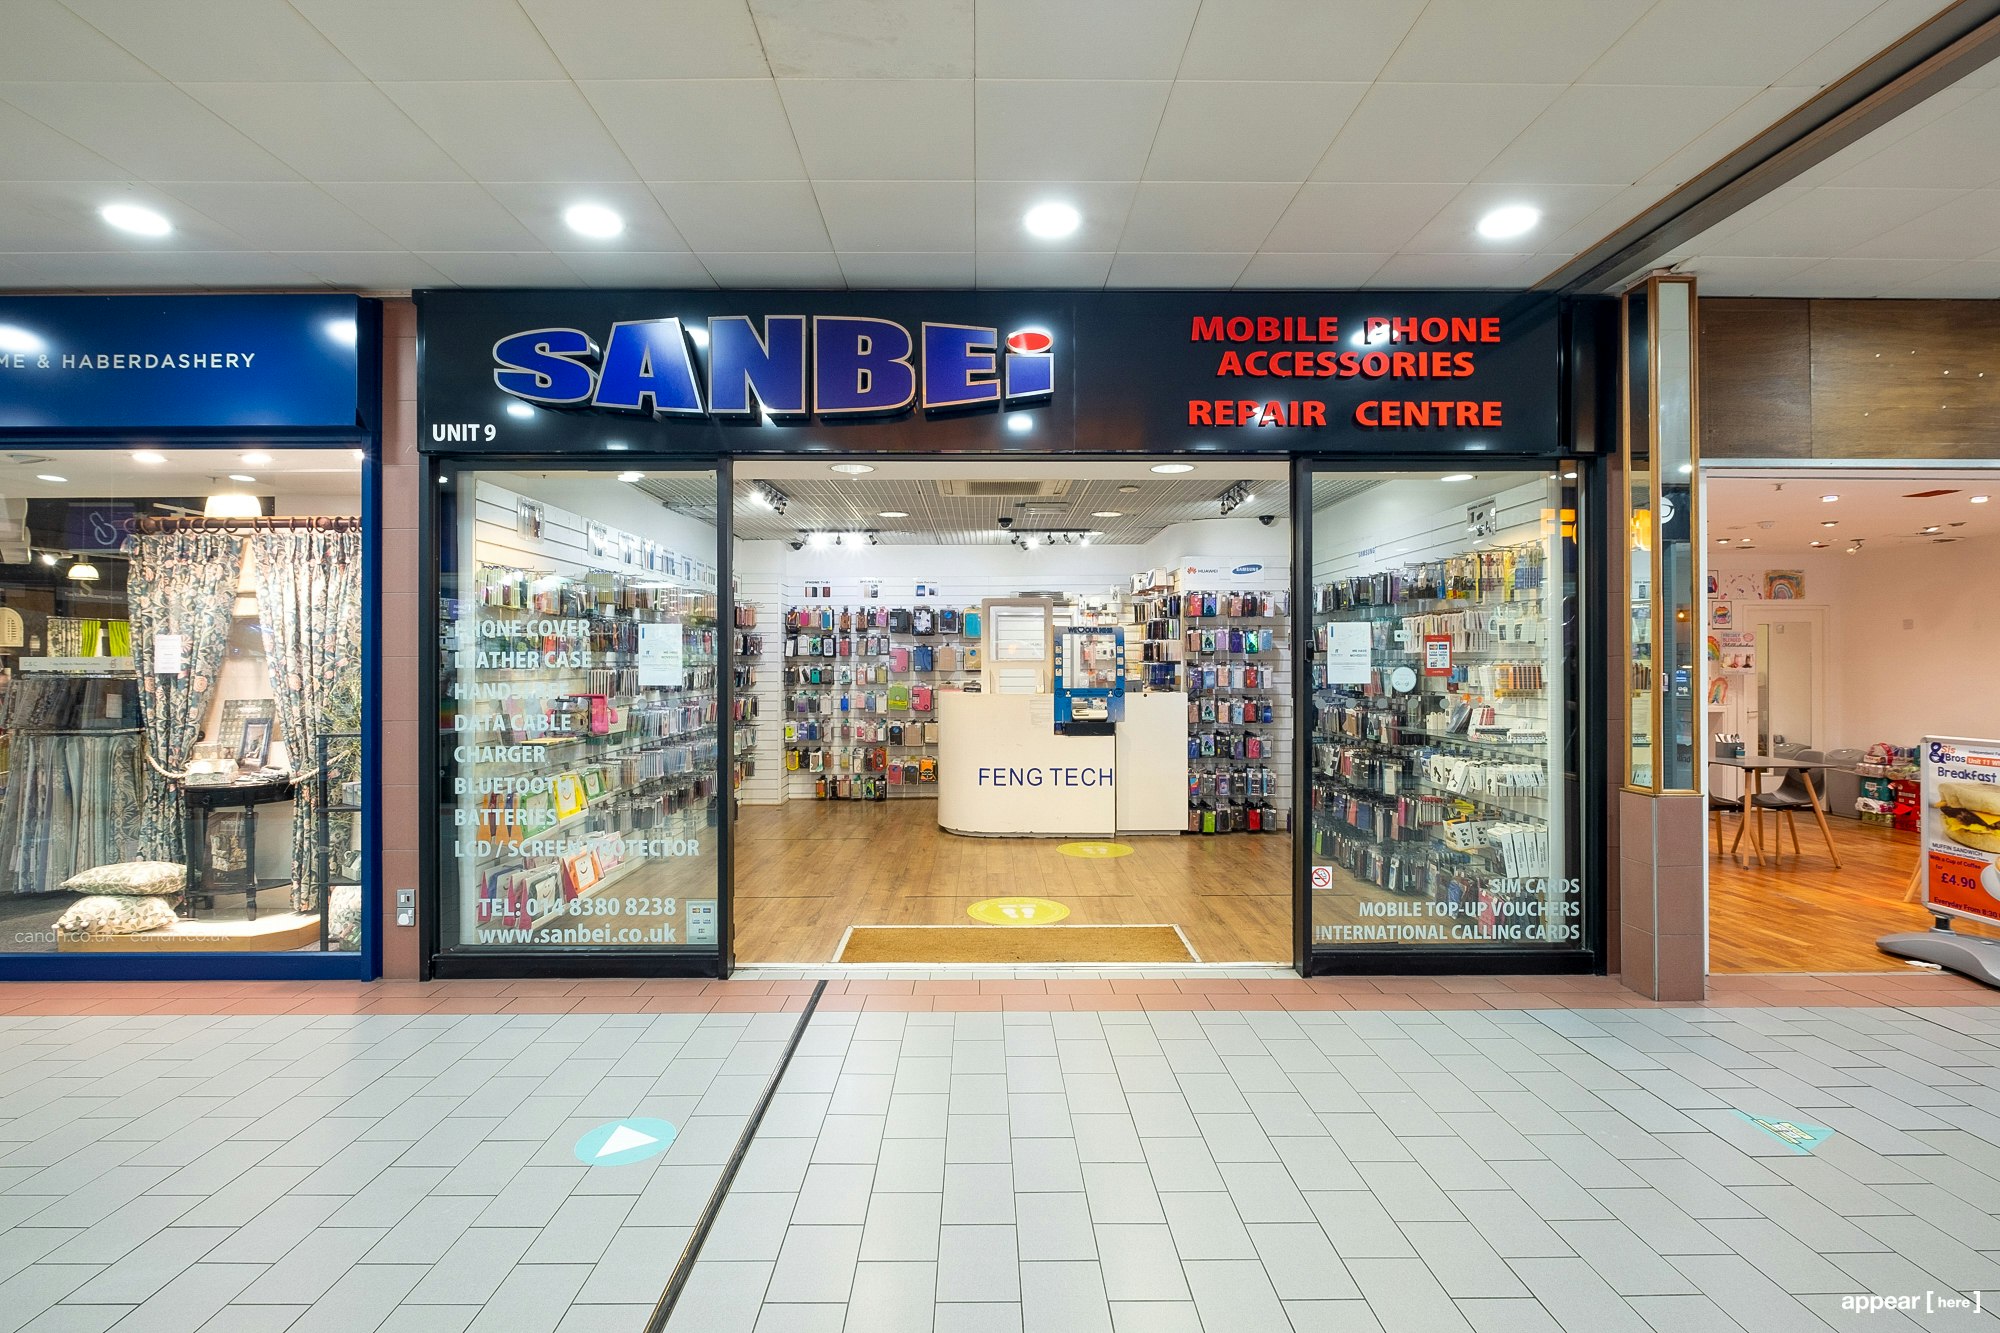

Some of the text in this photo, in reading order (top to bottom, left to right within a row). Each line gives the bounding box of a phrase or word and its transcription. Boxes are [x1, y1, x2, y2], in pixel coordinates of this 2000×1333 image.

[1191, 316, 1500, 343] MOBILE PHONE
[37, 354, 50, 369] &
[62, 353, 256, 369] HABERDASHERY
[492, 314, 1055, 414] SANBEi
[1216, 351, 1475, 377] ACCESSORIES
[1188, 400, 1502, 427] REPAIR CENTRE
[432, 423, 496, 442] UNIT 9
[454, 619, 591, 637] PHONE COVER
[544, 651, 592, 669] CASE
[454, 682, 570, 700] HANDSREE
[454, 714, 571, 732] DATA CABLE
[453, 745, 546, 763] CHARGER
[1941, 745, 1956, 754] Sis
[1945, 753, 1966, 763] Bros
[979, 768, 1113, 787] FENG TECH
[1937, 766, 1997, 783] Breakfast
[454, 777, 573, 795] BLUETOOTH
[454, 808, 557, 826] BATTERIES
[454, 840, 491, 858] LCD
[507, 840, 581, 858] SCREEN
[586, 839, 700, 858] PROTECTOR
[1932, 843, 1983, 857] MUFFIN SANDWICH
[1946, 858, 1956, 866] Cup
[1963, 861, 1982, 870] Coffee
[1490, 878, 1580, 894] SIM CARDS
[1941, 872, 1976, 890] £4.90
[479, 898, 521, 917] TEL:
[569, 898, 620, 917] 8380
[625, 897, 676, 917] 8238
[1359, 901, 1580, 917] MOBILE TOP-UP VOUCHERS
[1934, 896, 1962, 910] Everyday
[1964, 903, 1981, 914] From
[478, 922, 676, 944] www.sanbei.co.uk
[1315, 924, 1580, 940] INTERNATIONAL CALLING CARDS
